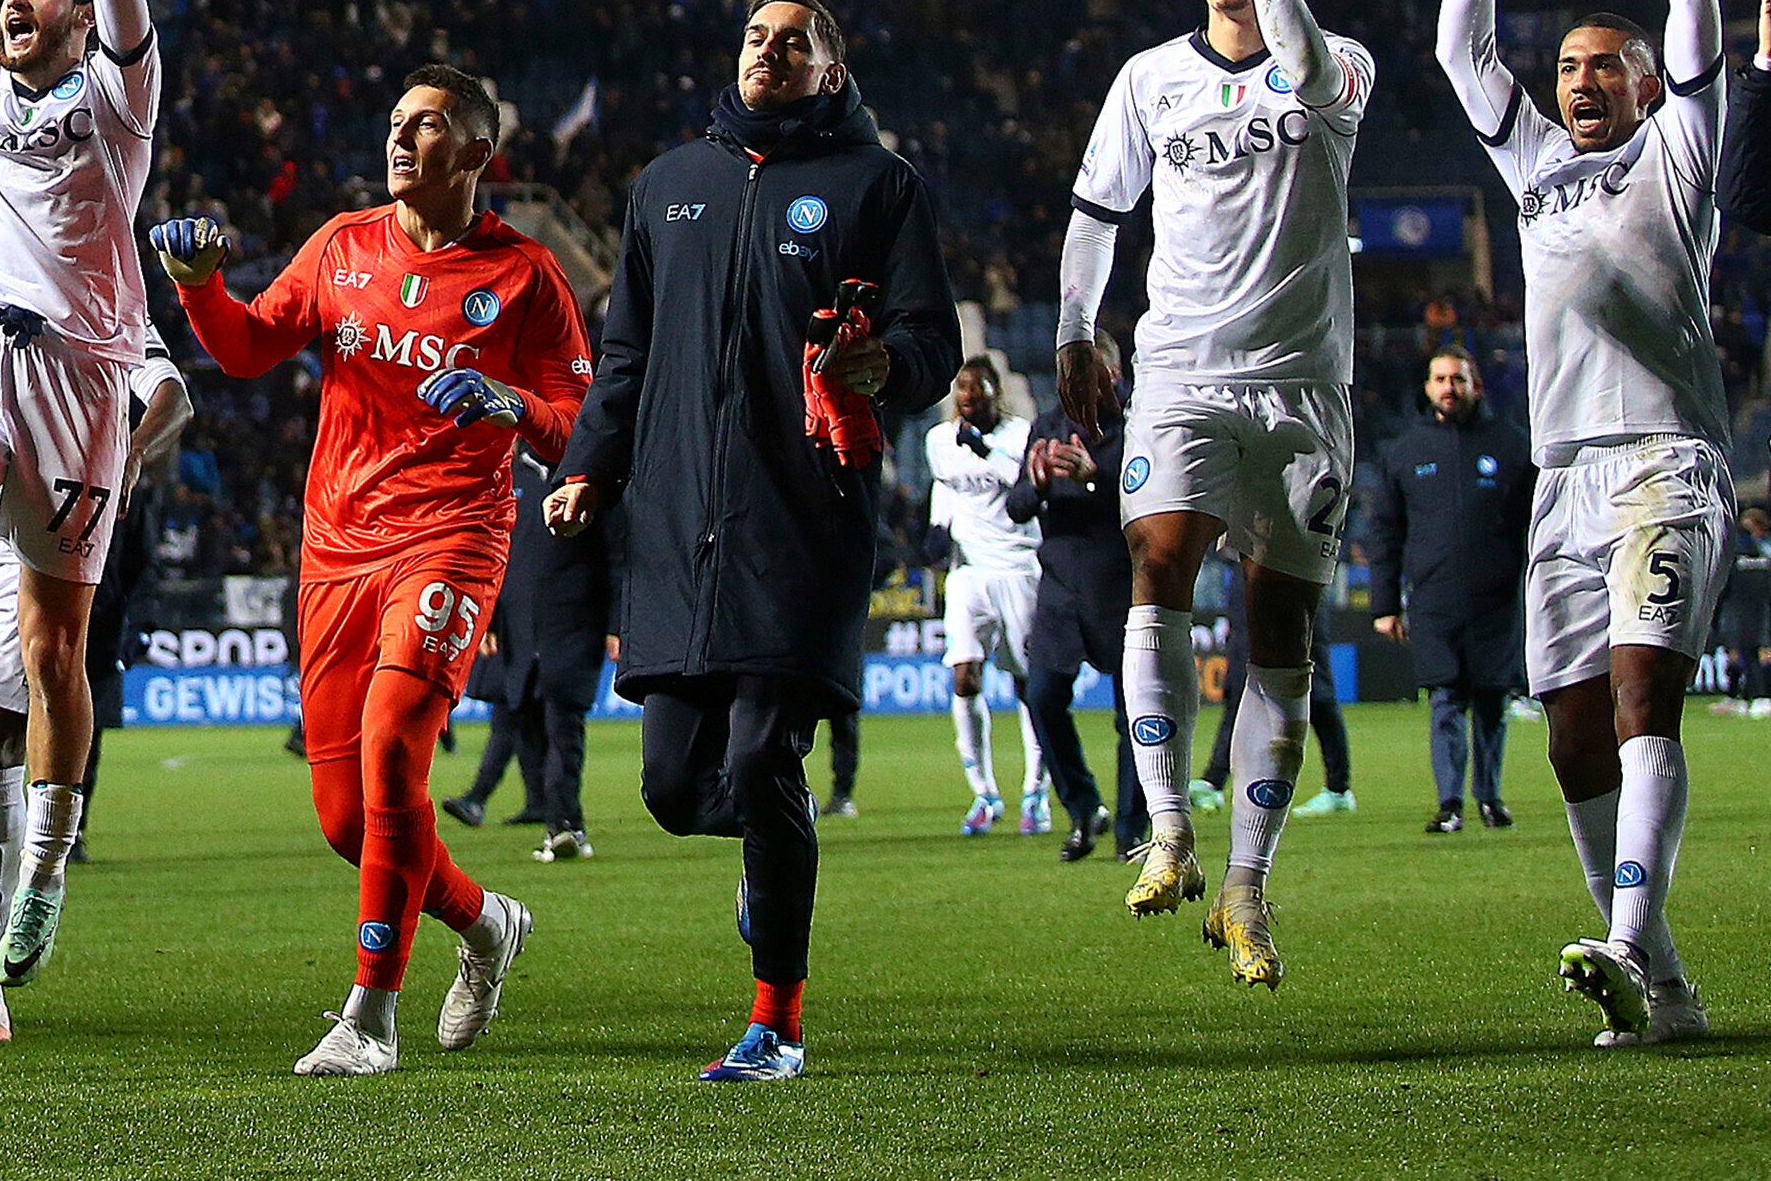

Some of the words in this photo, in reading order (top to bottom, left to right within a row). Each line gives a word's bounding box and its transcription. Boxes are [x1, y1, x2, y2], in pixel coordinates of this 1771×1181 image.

[1206, 109, 1310, 165] MSC
[666, 203, 706, 221] EA7
[778, 240, 820, 262] ebay
[333, 269, 372, 289] EA7
[370, 323, 480, 371] MSC
[46, 477, 111, 541] 77
[58, 536, 96, 558] EA7
[1646, 552, 1680, 605] 5
[414, 581, 481, 650] 95
[422, 635, 460, 662] EA7
